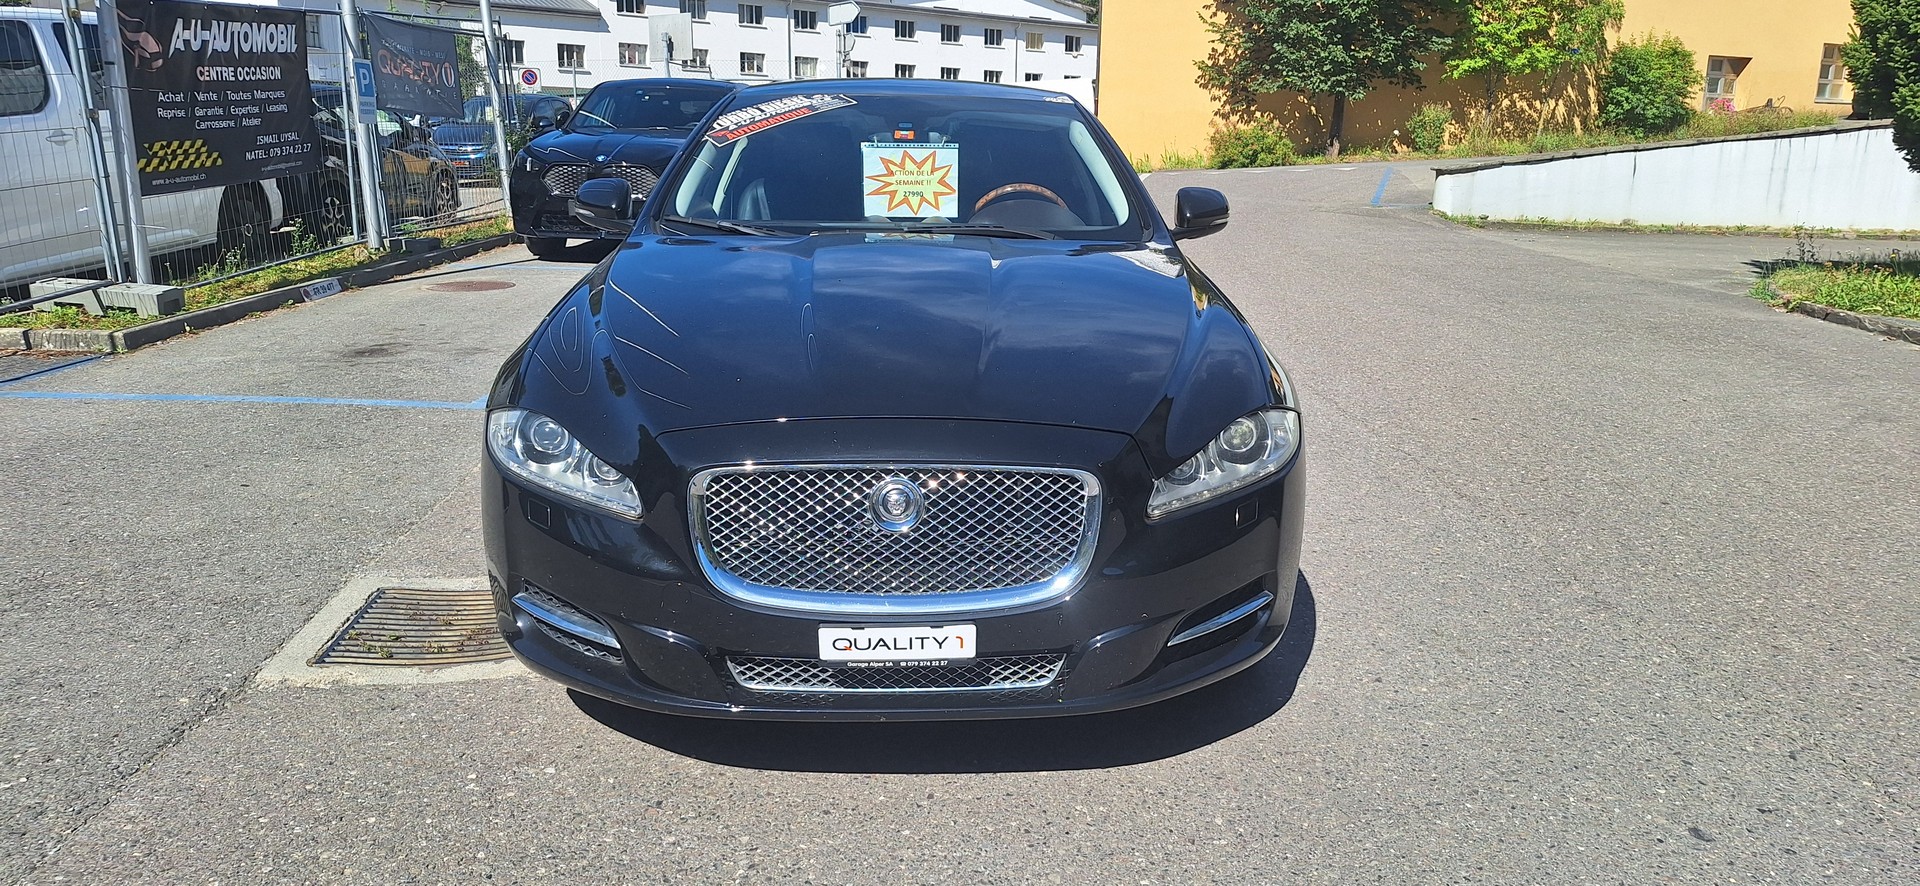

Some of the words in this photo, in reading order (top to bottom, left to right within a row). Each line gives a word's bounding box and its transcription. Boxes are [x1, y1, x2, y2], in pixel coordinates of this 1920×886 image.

[168, 18, 298, 60] A-U-AUTOMOBIL
[196, 66, 235, 82] CENTRE
[237, 66, 281, 81] OCCASION
[359, 68, 370, 93] P
[157, 90, 184, 103] Achat
[194, 90, 218, 102] Vente
[226, 90, 252, 101] Toutes
[253, 89, 286, 101] Marques
[157, 107, 186, 120] Reprise
[194, 106, 224, 117] Garantie
[230, 104, 260, 116] Expertise
[265, 103, 288, 114] Leasing
[195, 119, 235, 131] Carrosserie
[241, 117, 262, 127] Atelier
[726, 107, 813, 140] AUTOMATIQUE
[256, 134, 280, 145] ISMAIL
[280, 132, 299, 143] UYSAL
[245, 149, 269, 161] NATEL:
[269, 147, 281, 158] 079
[281, 146, 294, 156] 374
[294, 145, 303, 155] 22
[303, 143, 312, 153] 27
[832, 636, 949, 651] QUALITY
[955, 636, 964, 649] 1
